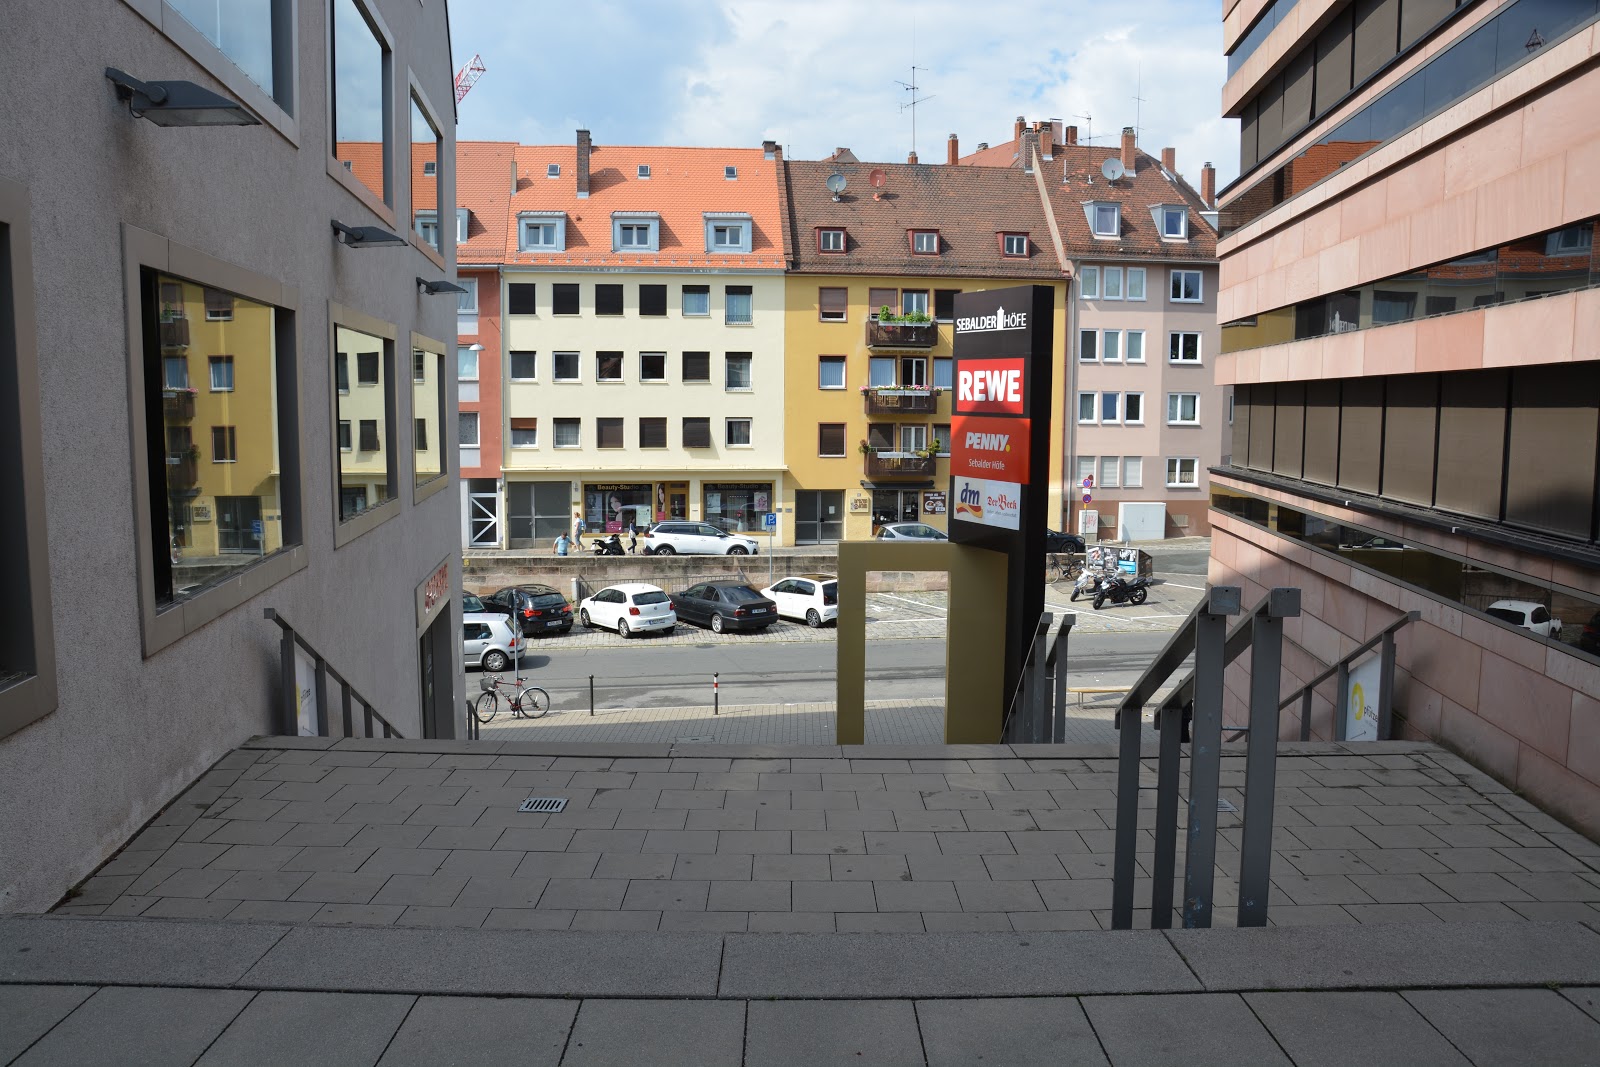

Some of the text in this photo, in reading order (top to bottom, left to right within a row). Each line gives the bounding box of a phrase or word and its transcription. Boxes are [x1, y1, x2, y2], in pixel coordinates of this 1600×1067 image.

[956, 312, 1027, 331] SEBALDER HÖFE
[958, 370, 1020, 402] REWE
[968, 458, 1006, 471] Sebalder Höfe
[960, 482, 980, 505] dm
[987, 493, 1017, 511] Der Beck
